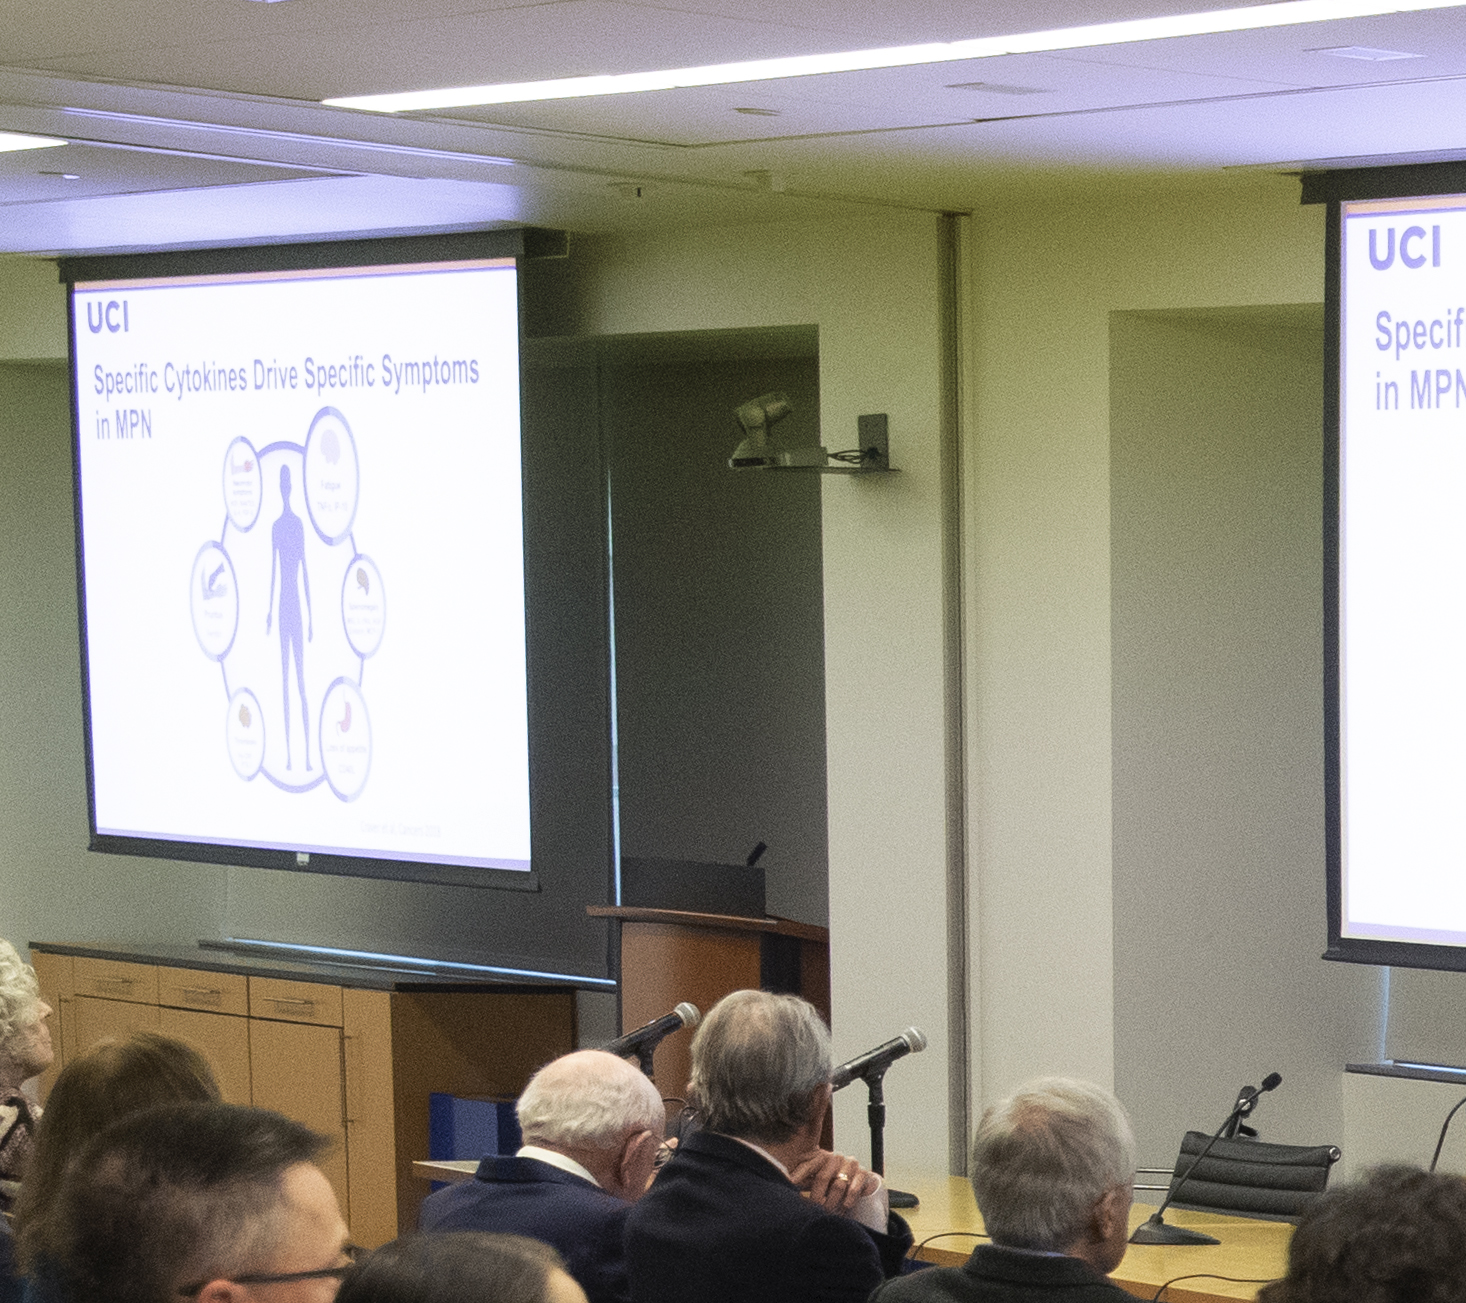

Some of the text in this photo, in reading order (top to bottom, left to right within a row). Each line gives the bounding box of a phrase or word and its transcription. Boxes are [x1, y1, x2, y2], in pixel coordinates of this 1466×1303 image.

[1366, 224, 1442, 272] UCI
[86, 299, 130, 334] UCI
[93, 353, 481, 402] Specific Cytokines Drive Specific Symptoms
[1374, 371, 1400, 411] in
[95, 408, 153, 440] in MPN
